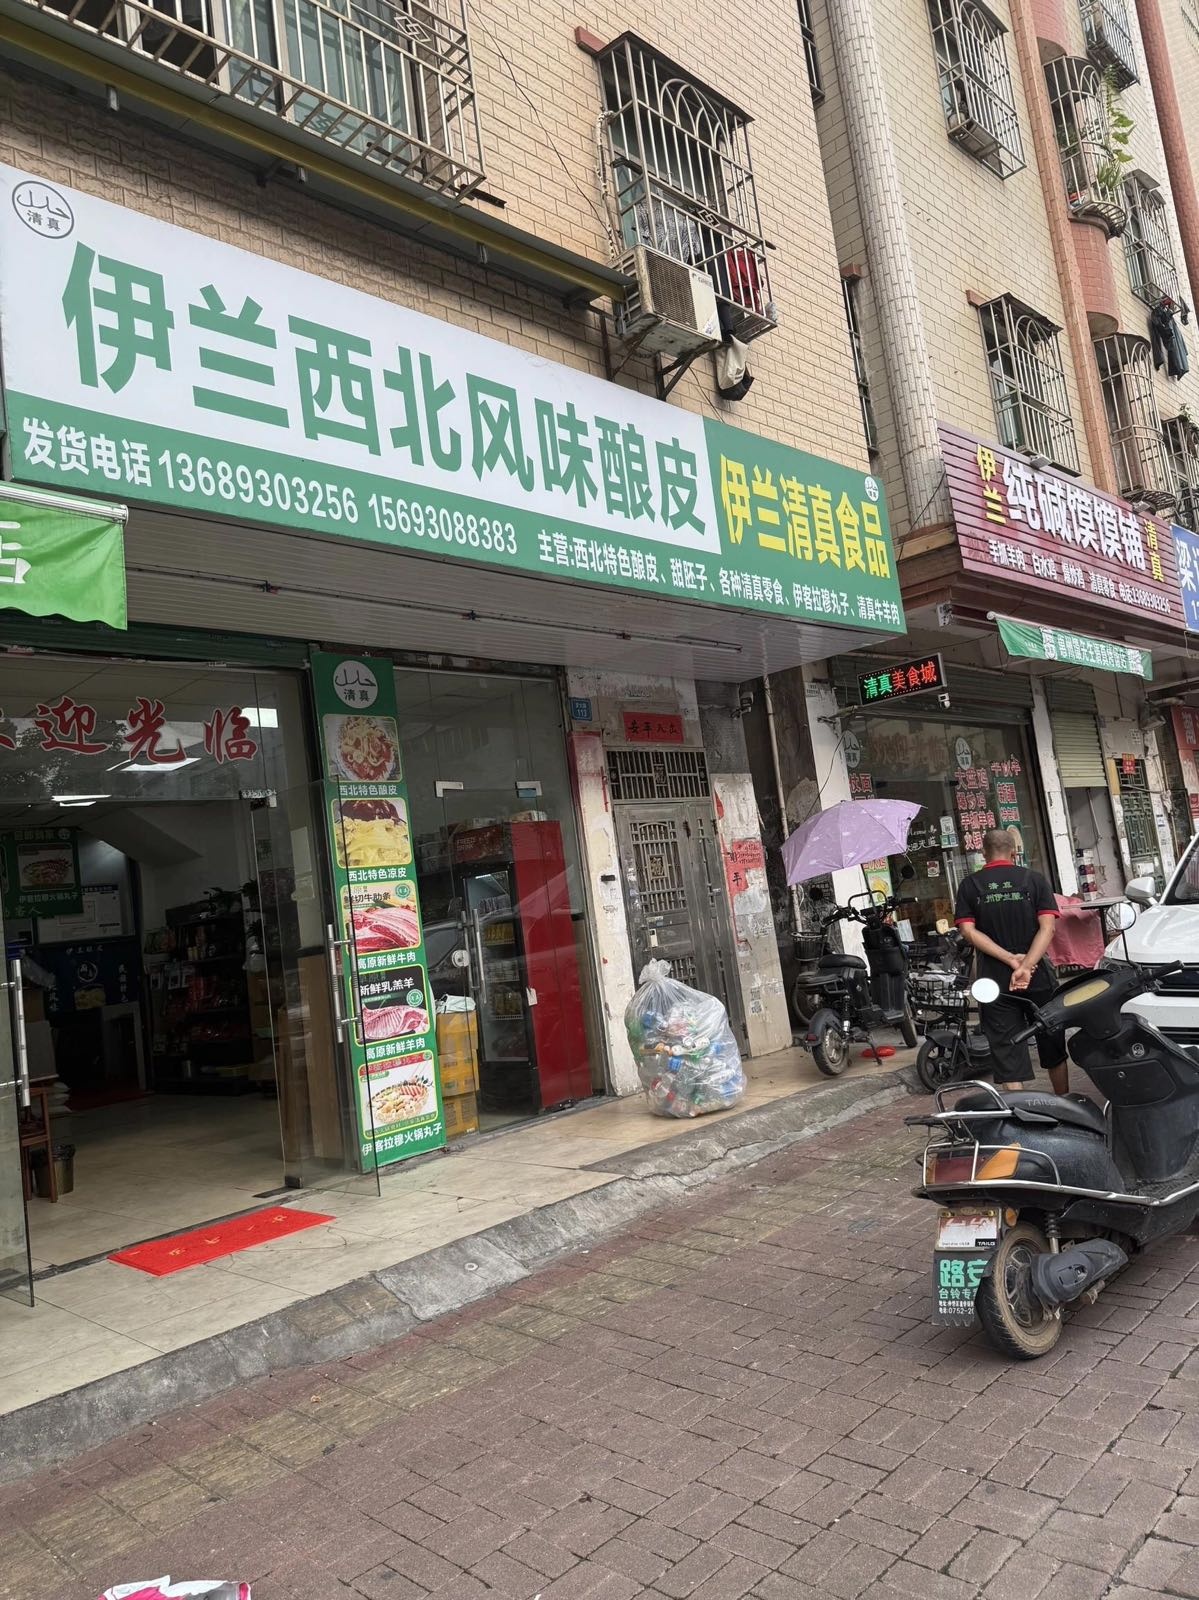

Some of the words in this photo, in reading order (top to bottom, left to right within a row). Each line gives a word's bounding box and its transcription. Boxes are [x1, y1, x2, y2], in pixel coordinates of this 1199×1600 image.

[26, 210, 61, 231] 清真
[62, 241, 707, 536] 伊兰西北风味酿皮
[22, 417, 152, 488] 发货电话
[158, 450, 359, 524] 13689303256
[368, 492, 518, 555] 15693088383
[976, 443, 1007, 525] 伊兰
[719, 453, 891, 580] 伊兰清真食品
[1002, 456, 1146, 572] 纯碱馍馍铺
[1144, 518, 1164, 584] 清真
[343, 688, 370, 702] 清真
[863, 660, 938, 699] 清真美食城
[338, 783, 399, 796] 西北特色酿皮
[347, 867, 407, 882] 西北特色凉皮
[365, 1037, 426, 1060] 高原新鲜羊肉
